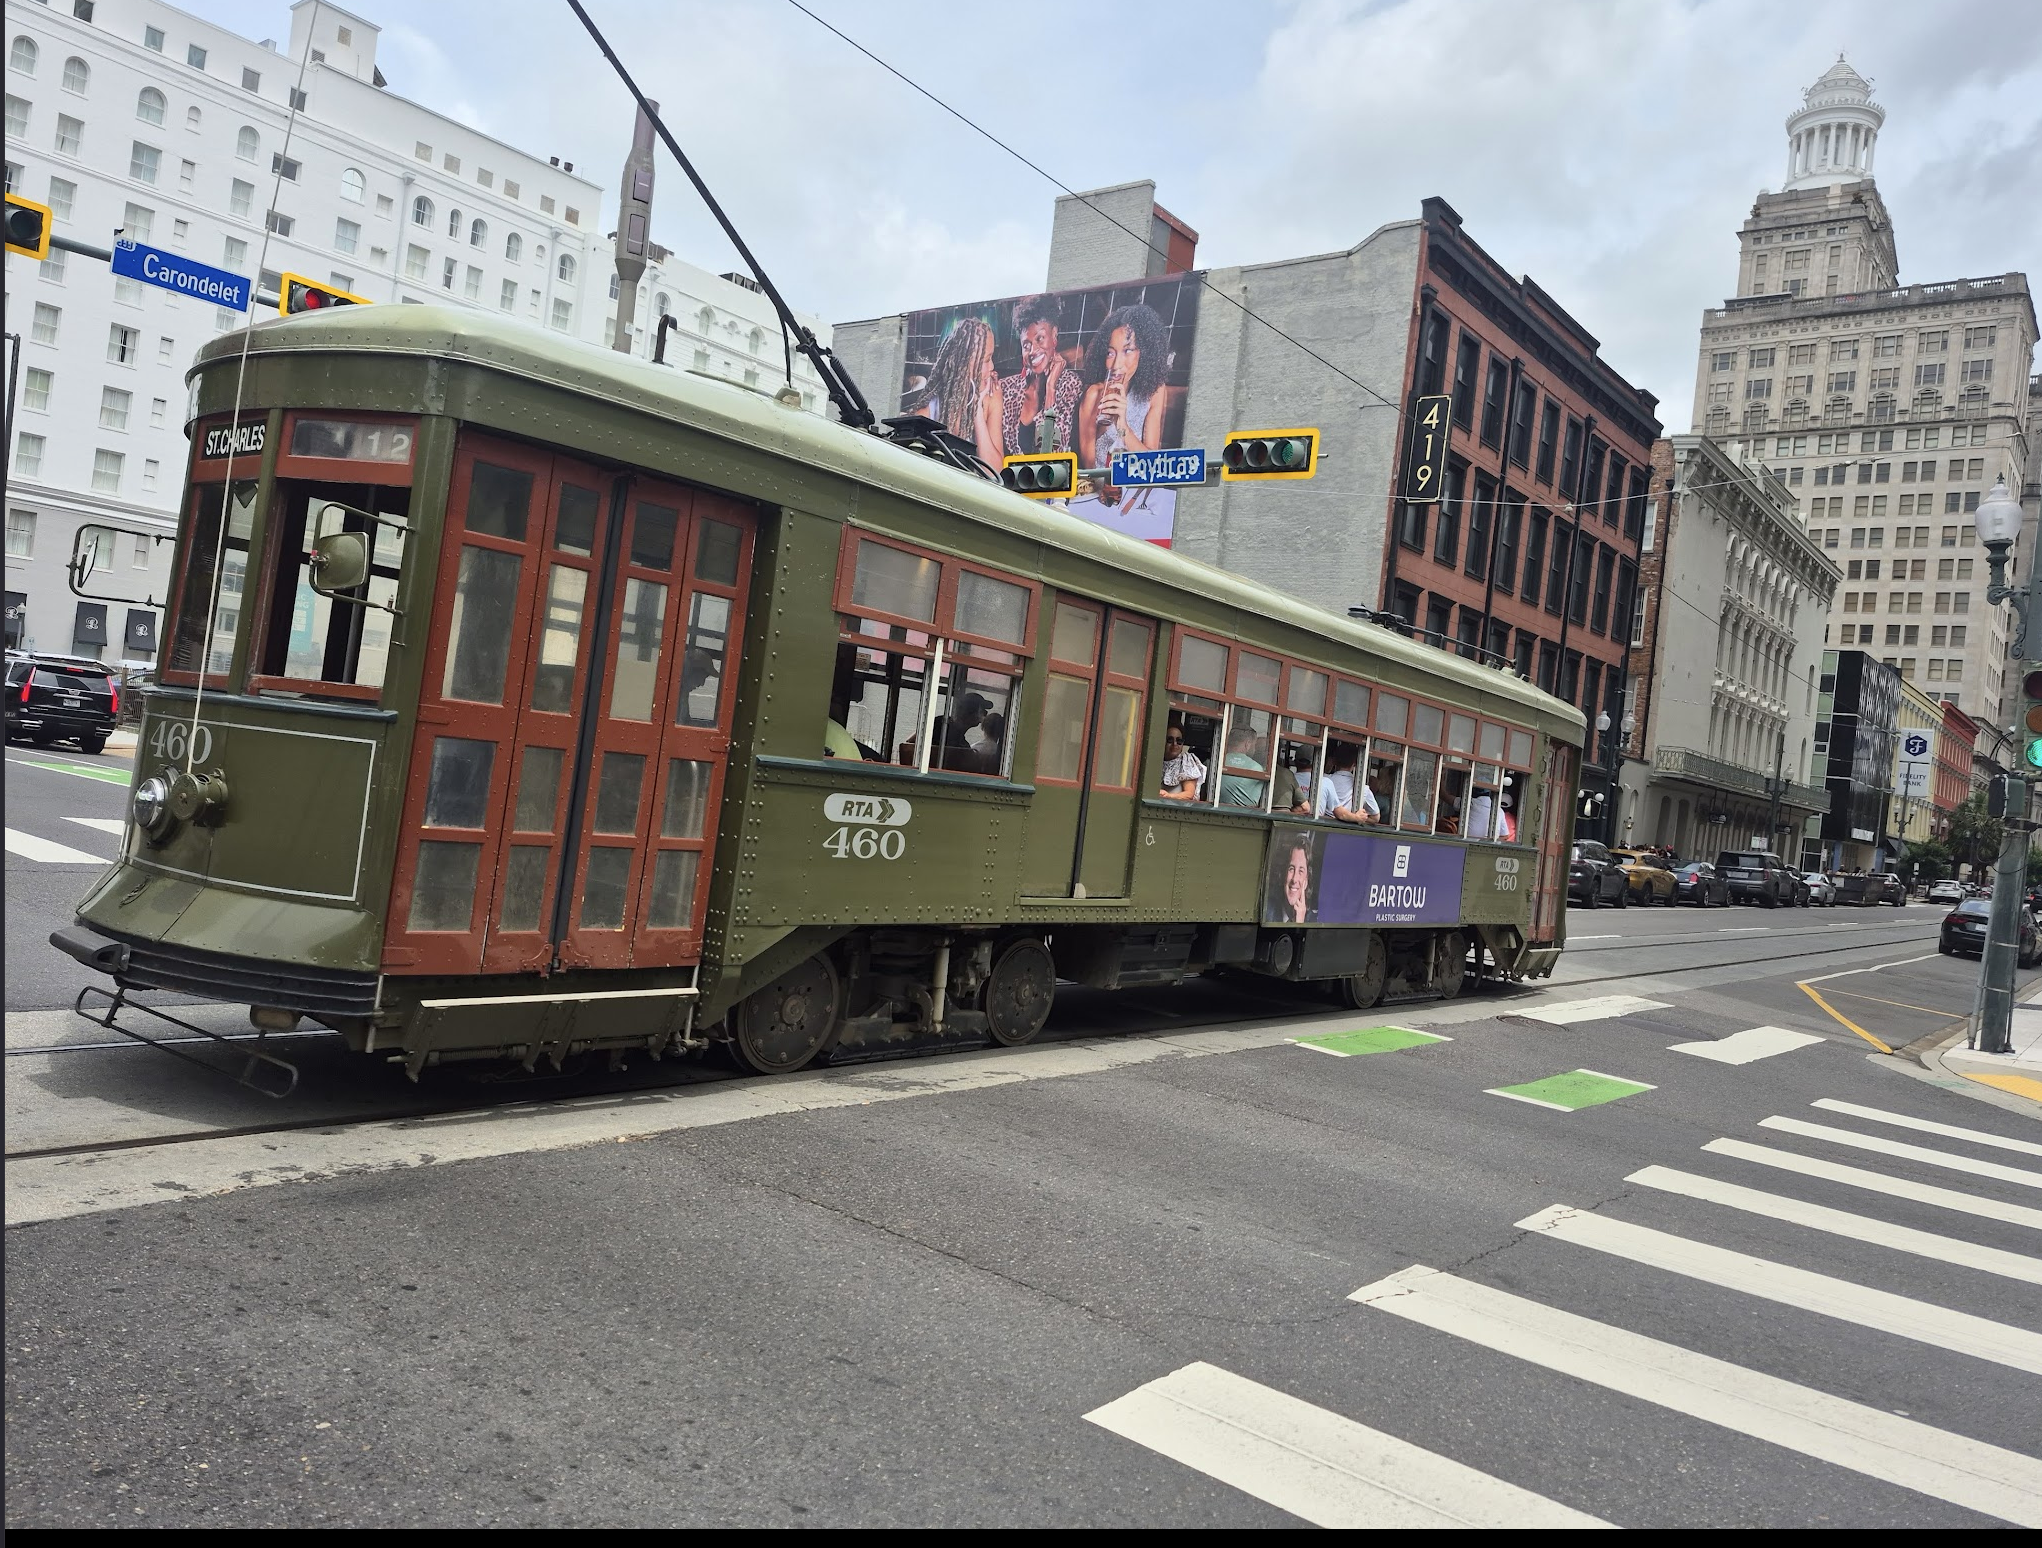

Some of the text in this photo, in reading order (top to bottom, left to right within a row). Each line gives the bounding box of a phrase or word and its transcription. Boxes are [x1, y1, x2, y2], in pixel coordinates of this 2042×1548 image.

[143, 253, 240, 304] Carondelet
[1417, 402, 1440, 491] 419
[150, 720, 212, 765] 460
[1899, 772, 1926, 780] FIELITY
[841, 800, 874, 818] RTA
[822, 826, 906, 861] 460
[1500, 860, 1510, 870] RTA
[1494, 873, 1517, 892] 460
[1368, 884, 1427, 909] BARTOW
[1375, 913, 1417, 922] PLASTIC SURGERY
